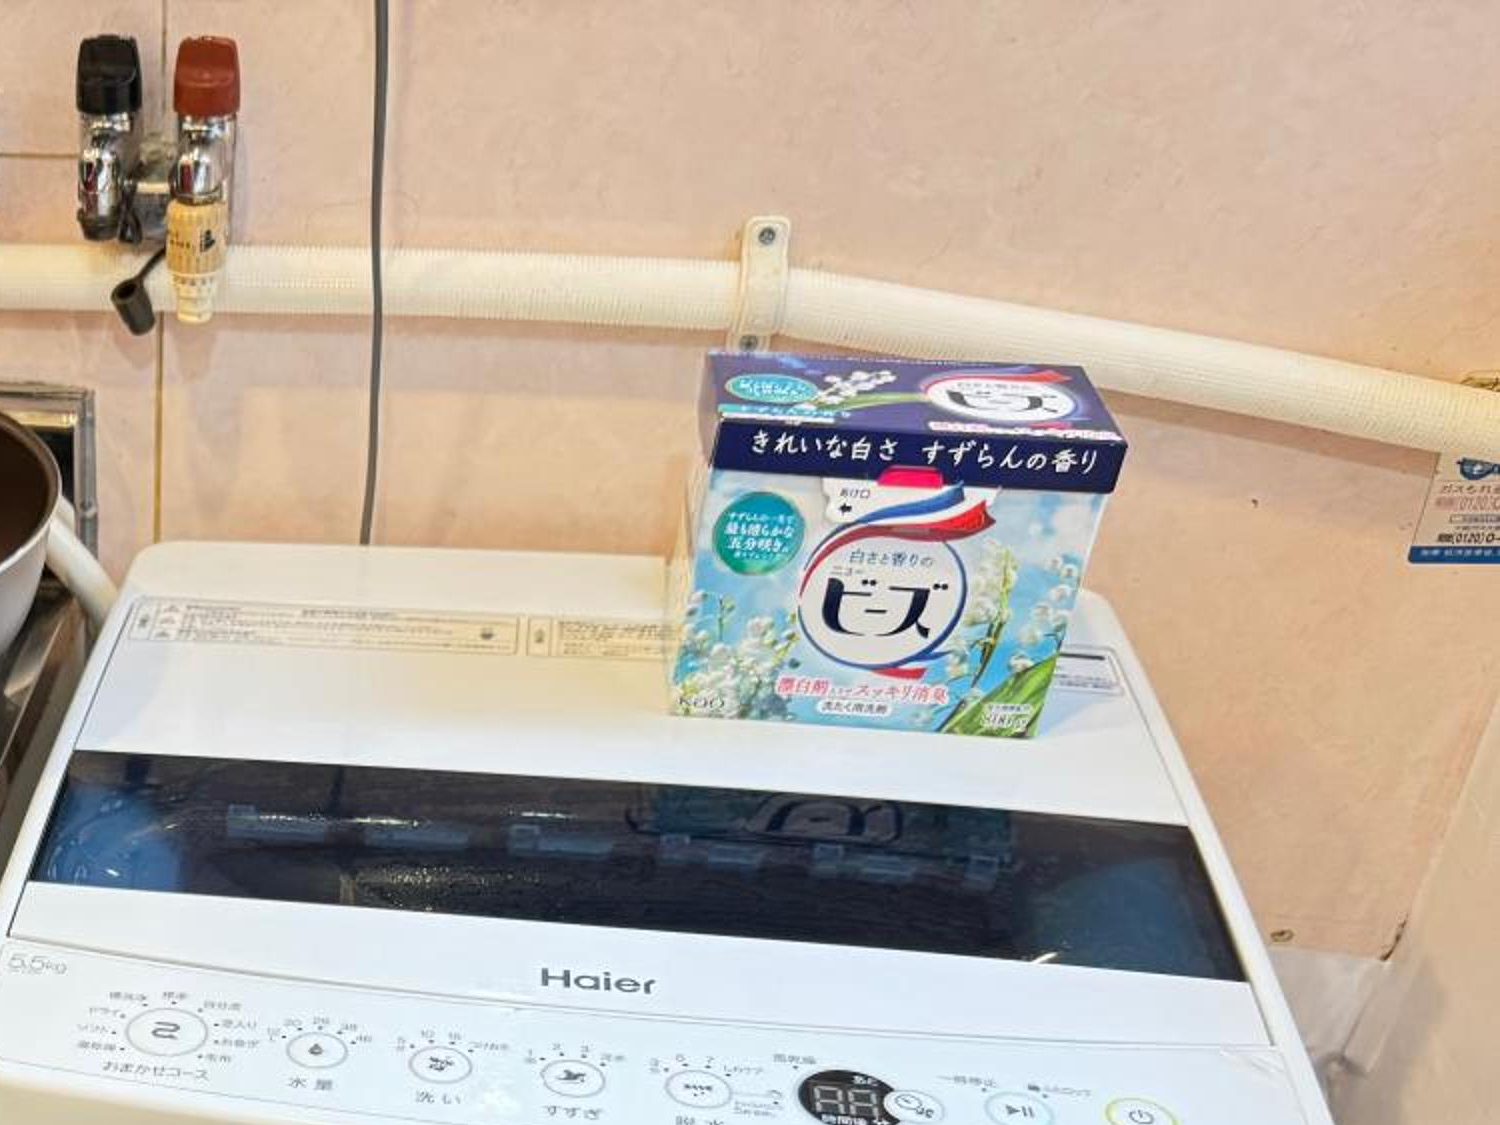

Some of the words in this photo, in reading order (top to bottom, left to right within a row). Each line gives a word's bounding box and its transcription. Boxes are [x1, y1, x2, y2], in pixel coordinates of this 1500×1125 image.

[751, 430, 899, 461] きれいな白さ
[921, 438, 1098, 475] すずらんの香り
[849, 549, 933, 568] 白さと香りの
[821, 577, 949, 639] ビーズ
[541, 967, 656, 995] Haier
[102, 1061, 209, 1081] おまかせコース
